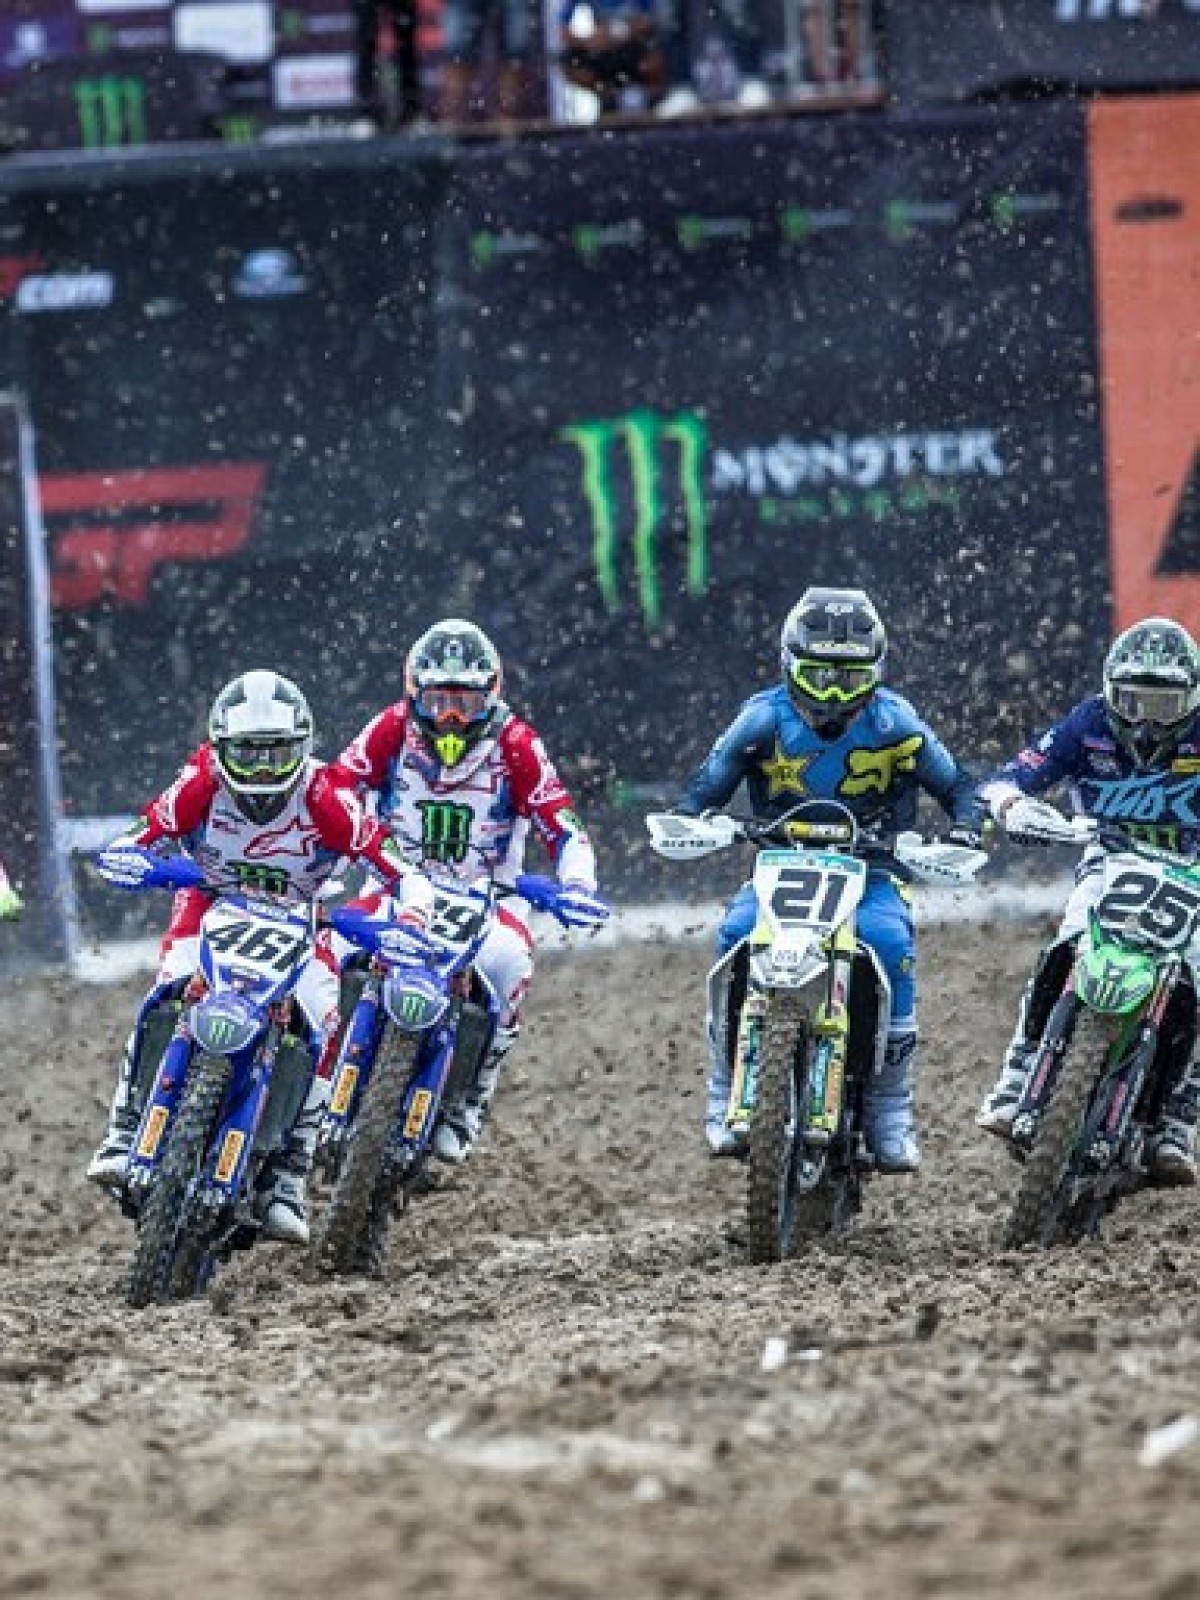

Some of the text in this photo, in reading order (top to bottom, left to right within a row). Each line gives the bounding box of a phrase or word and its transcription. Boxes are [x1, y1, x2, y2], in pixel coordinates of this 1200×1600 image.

[712, 429, 1003, 493] MONSTER
[770, 867, 848, 923] 21
[1097, 871, 1200, 943] 25
[205, 921, 311, 972] 461
